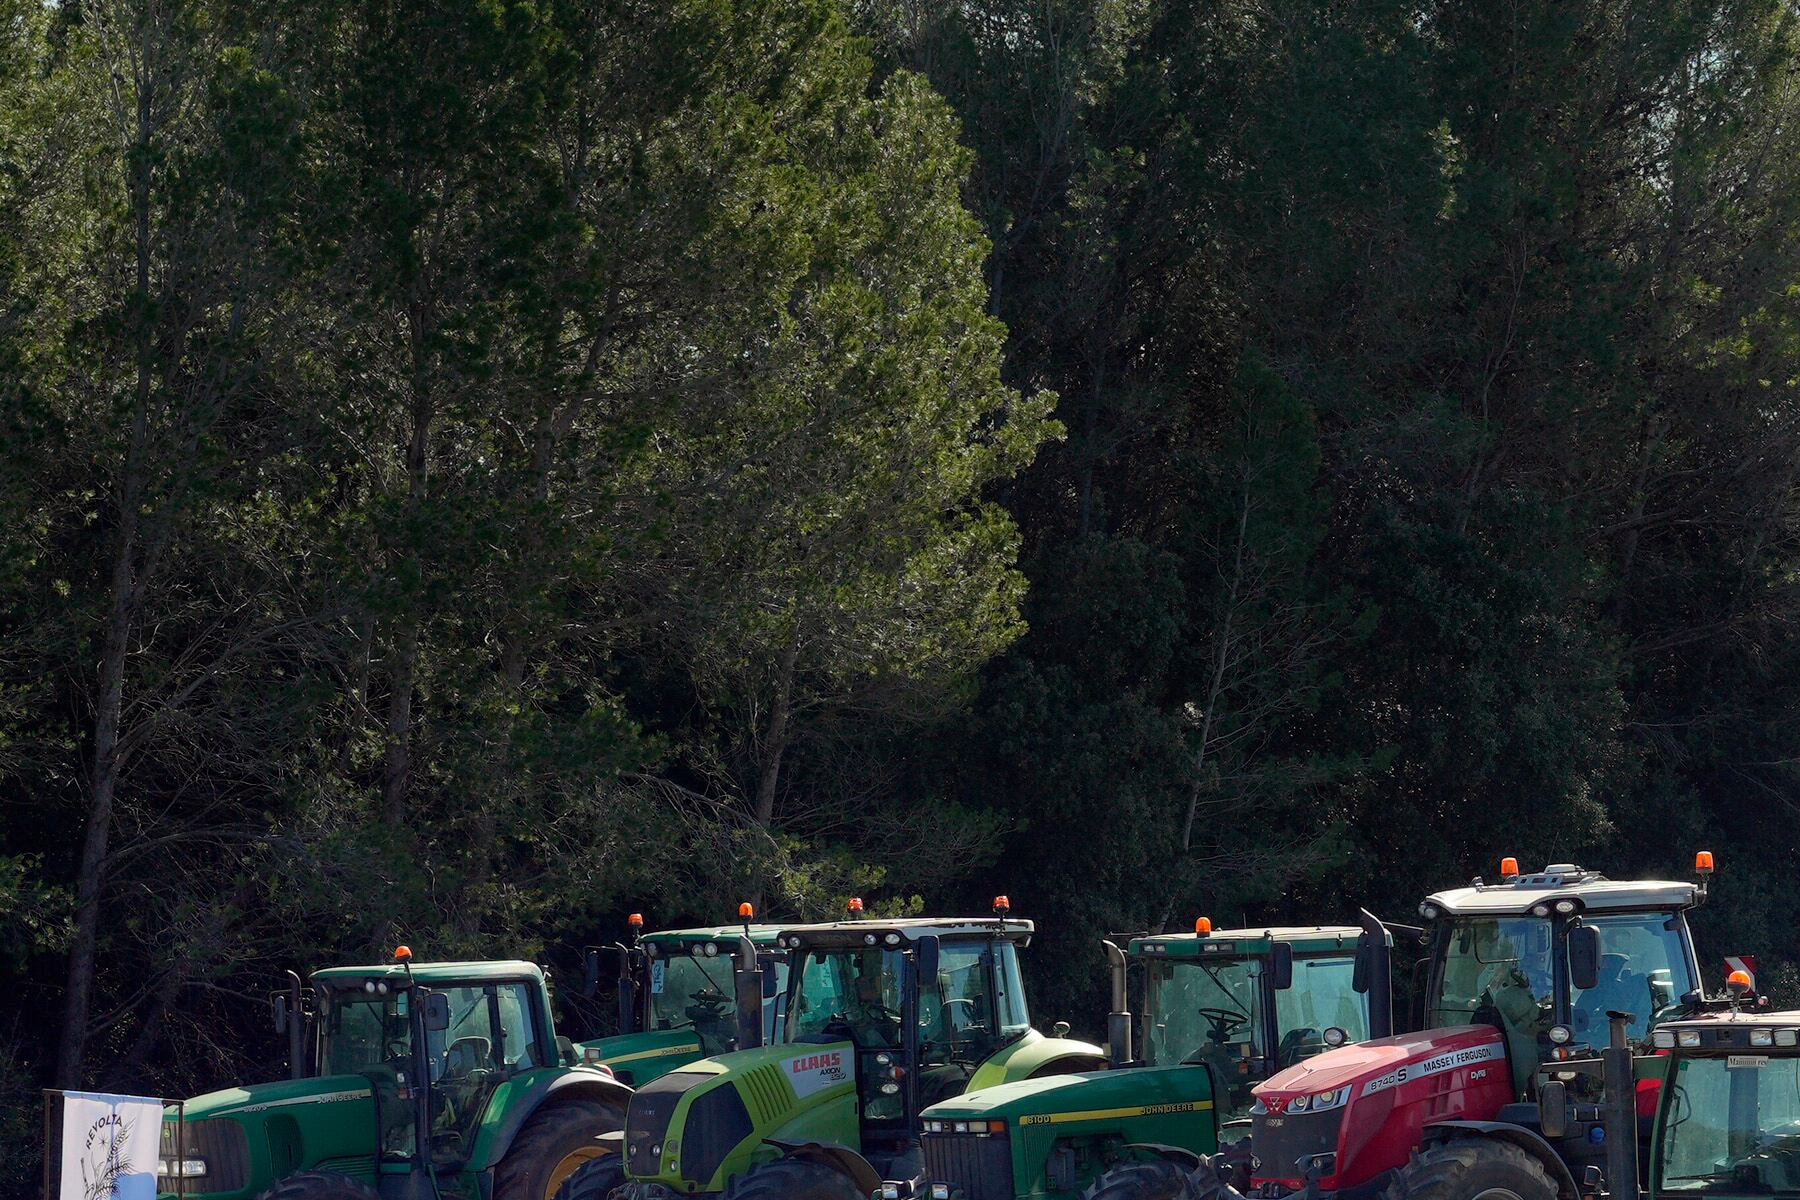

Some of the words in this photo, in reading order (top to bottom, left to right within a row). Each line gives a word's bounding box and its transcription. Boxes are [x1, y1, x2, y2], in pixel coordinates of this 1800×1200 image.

[793, 1053, 840, 1073] CLAAS
[1423, 1056, 1455, 1072] MASSEY
[1456, 1047, 1492, 1064] FERGUSON
[820, 1067, 841, 1076] AXION
[1397, 1068, 1407, 1082] S
[1142, 1106, 1165, 1115] JOHN
[1165, 1103, 1194, 1113] DEERE
[1027, 1115, 1051, 1125] 8100
[86, 1114, 123, 1150] REVOLTA
